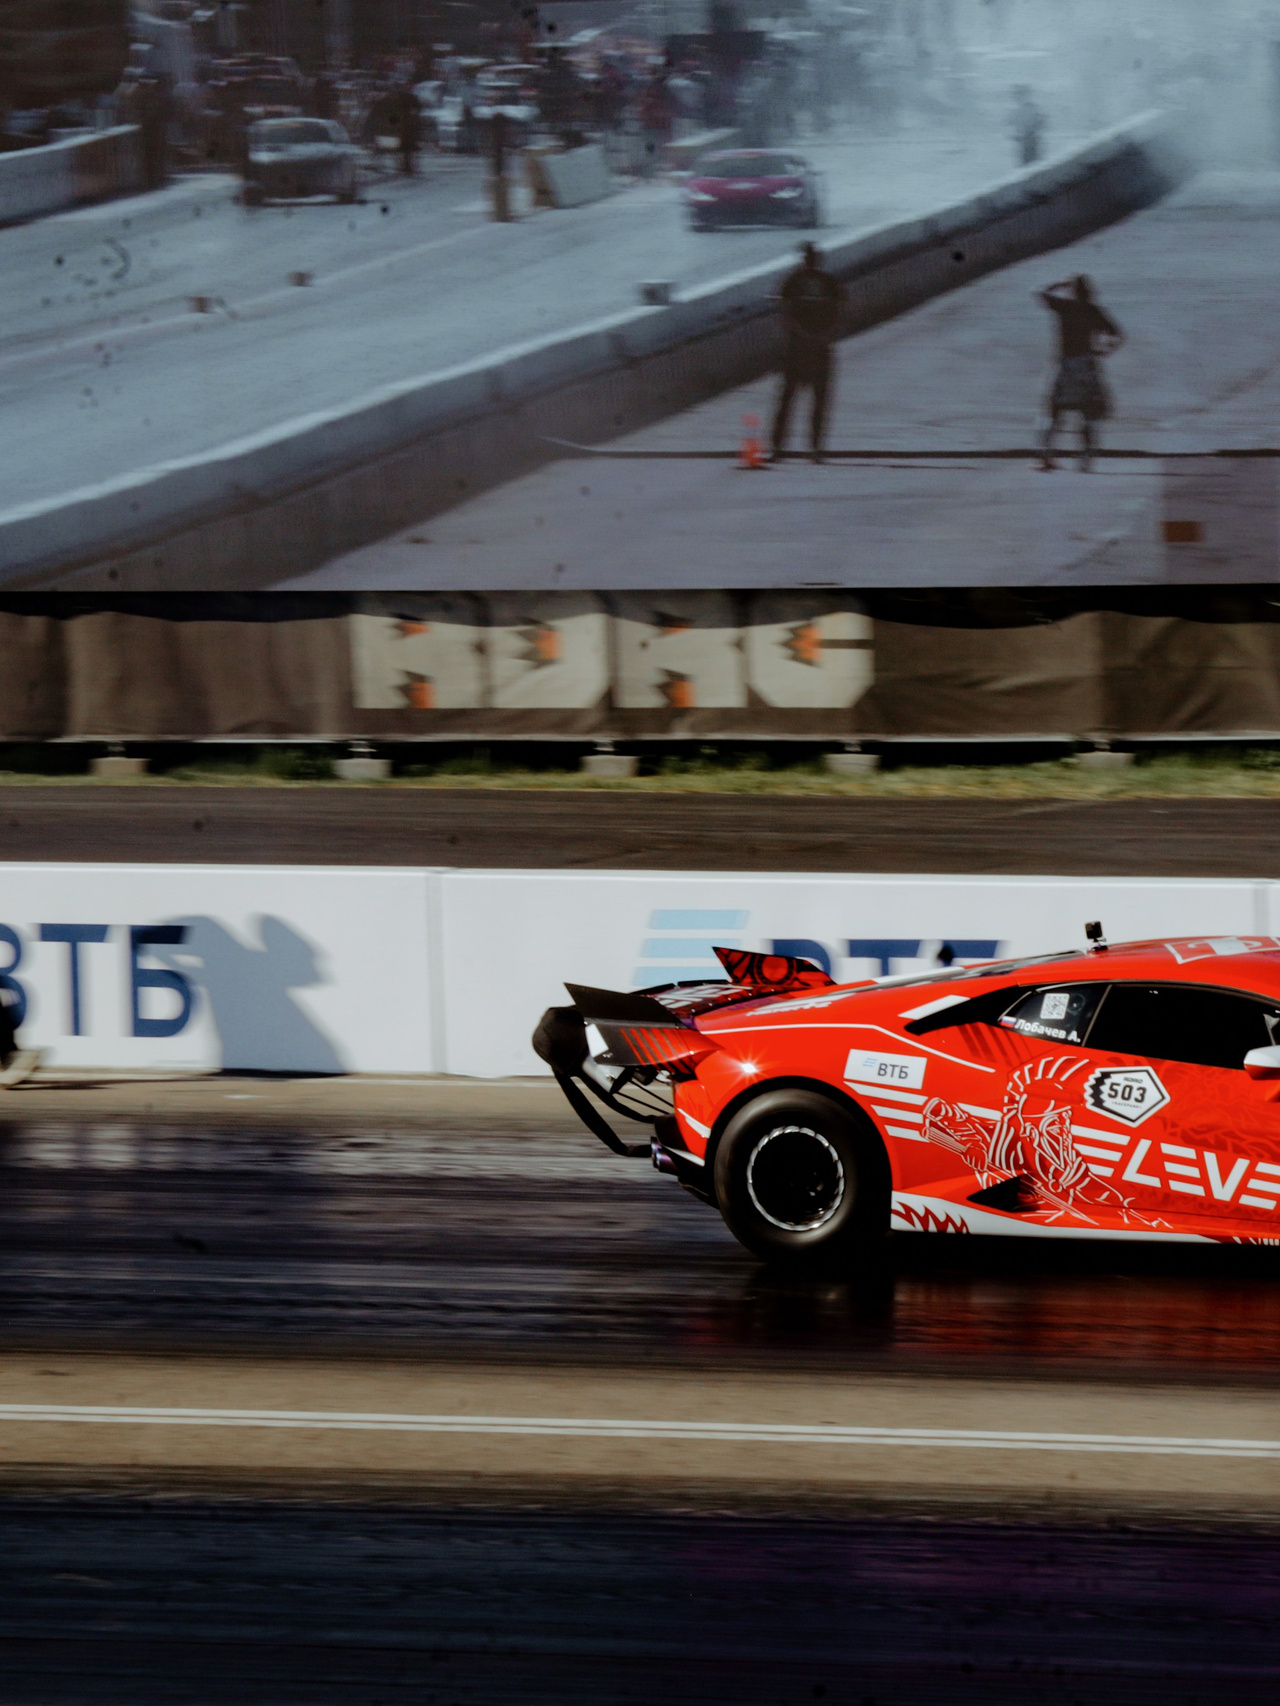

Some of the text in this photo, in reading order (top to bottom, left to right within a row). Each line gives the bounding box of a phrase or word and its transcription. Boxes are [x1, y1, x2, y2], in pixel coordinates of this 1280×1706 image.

[1014, 1019, 1082, 1043] Лобачев А.
[876, 1061, 910, 1081] ВТБ
[1107, 1082, 1147, 1104] 503
